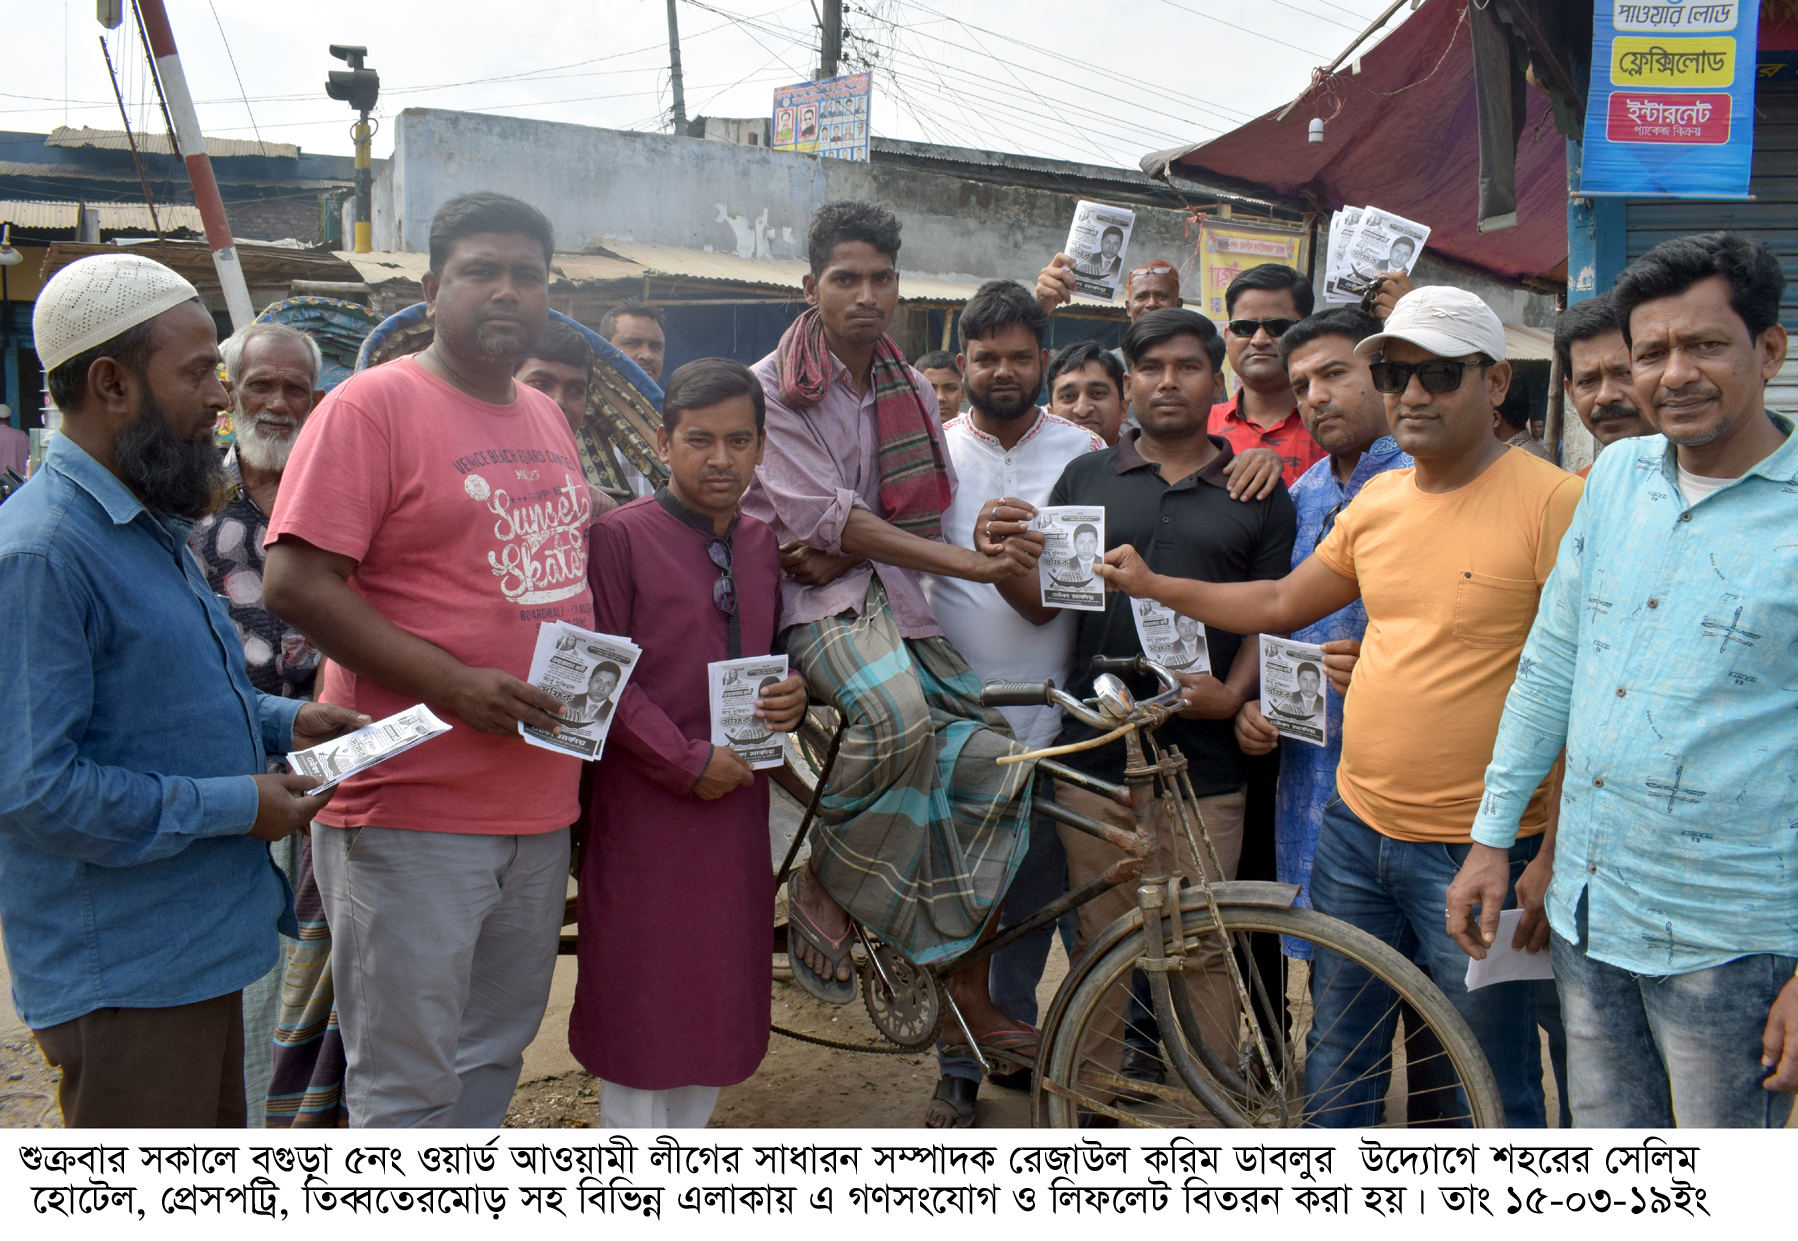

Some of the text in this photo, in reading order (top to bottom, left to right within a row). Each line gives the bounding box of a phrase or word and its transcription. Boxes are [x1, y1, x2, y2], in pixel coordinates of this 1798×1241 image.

[1618, 4, 1734, 26] পাওয়ার লোড
[1619, 46, 1727, 77] ফ্লেক্সিলোড
[1626, 99, 1713, 125] ইন্টারনেট
[1634, 124, 1702, 137] প্যাকেজ বিক্রয়
[452, 453, 490, 475] VENICE
[487, 449, 517, 464] BEACH
[518, 449, 546, 464] BOARD
